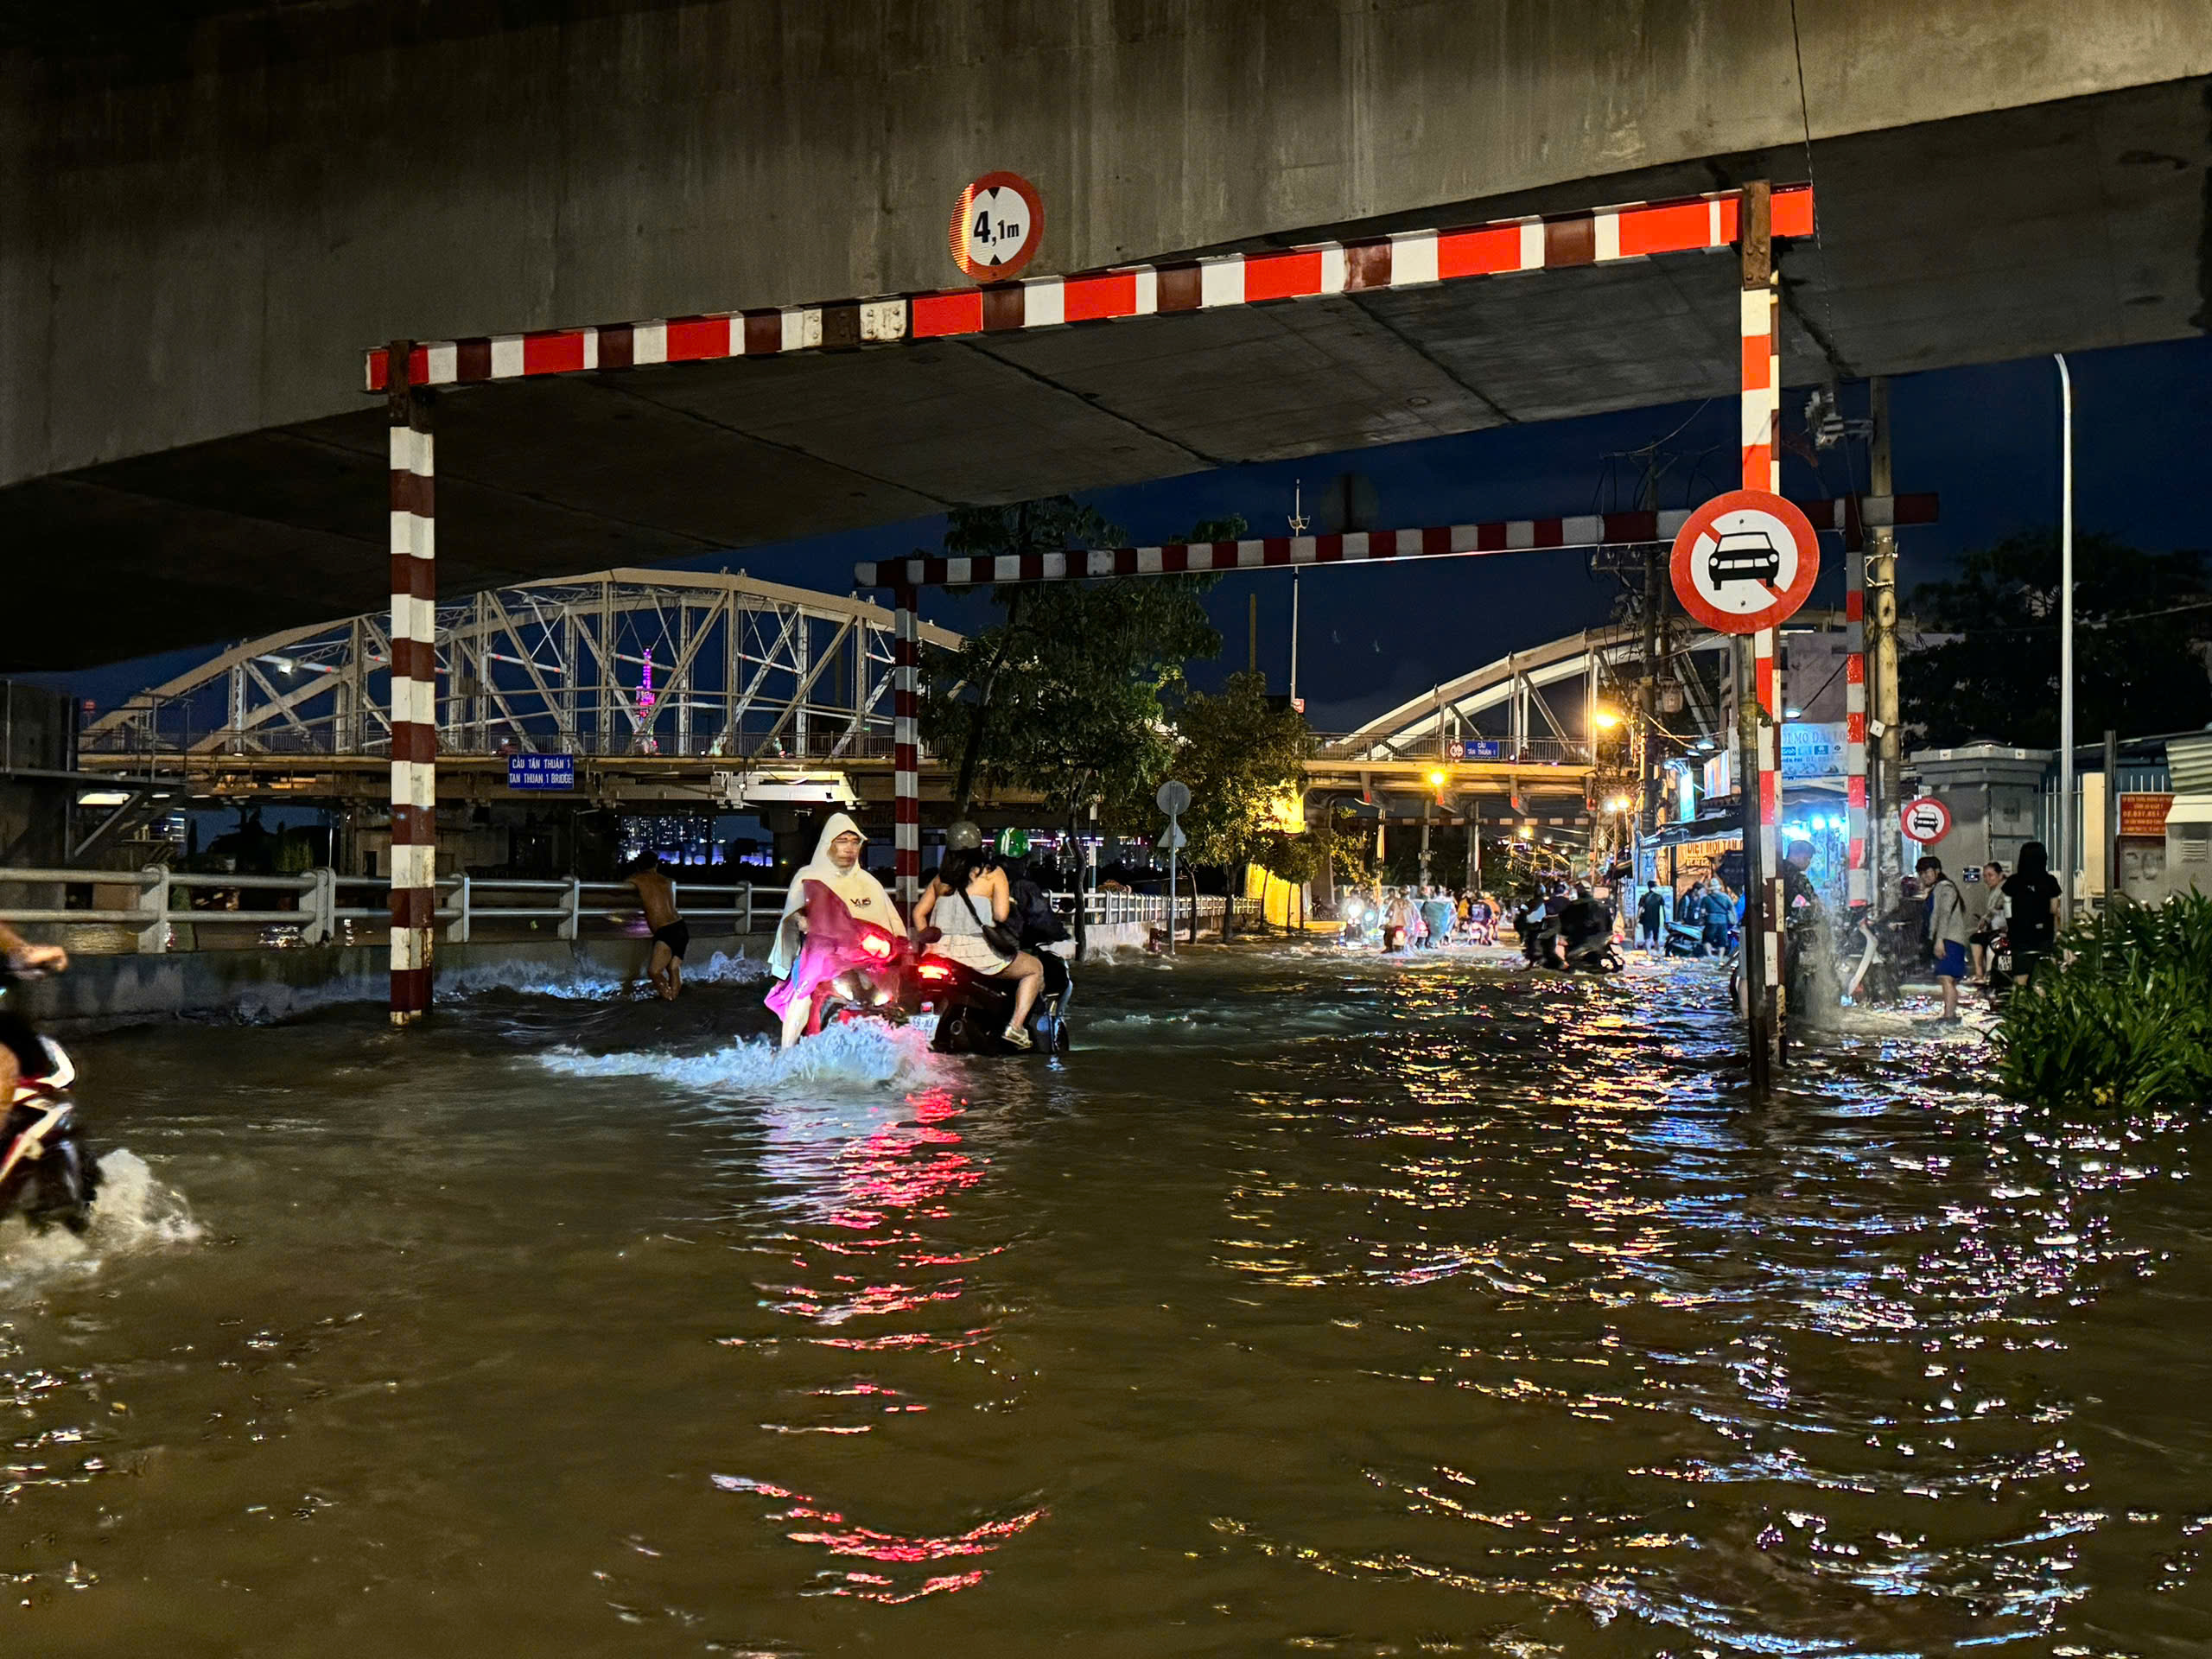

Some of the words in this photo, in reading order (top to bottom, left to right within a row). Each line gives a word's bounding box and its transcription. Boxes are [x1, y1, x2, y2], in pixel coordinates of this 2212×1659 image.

[974, 210, 1020, 246] 4,1m
[509, 772, 520, 784] TAN
[524, 773, 543, 784] THUAN
[550, 773, 572, 785] BRIDGE
